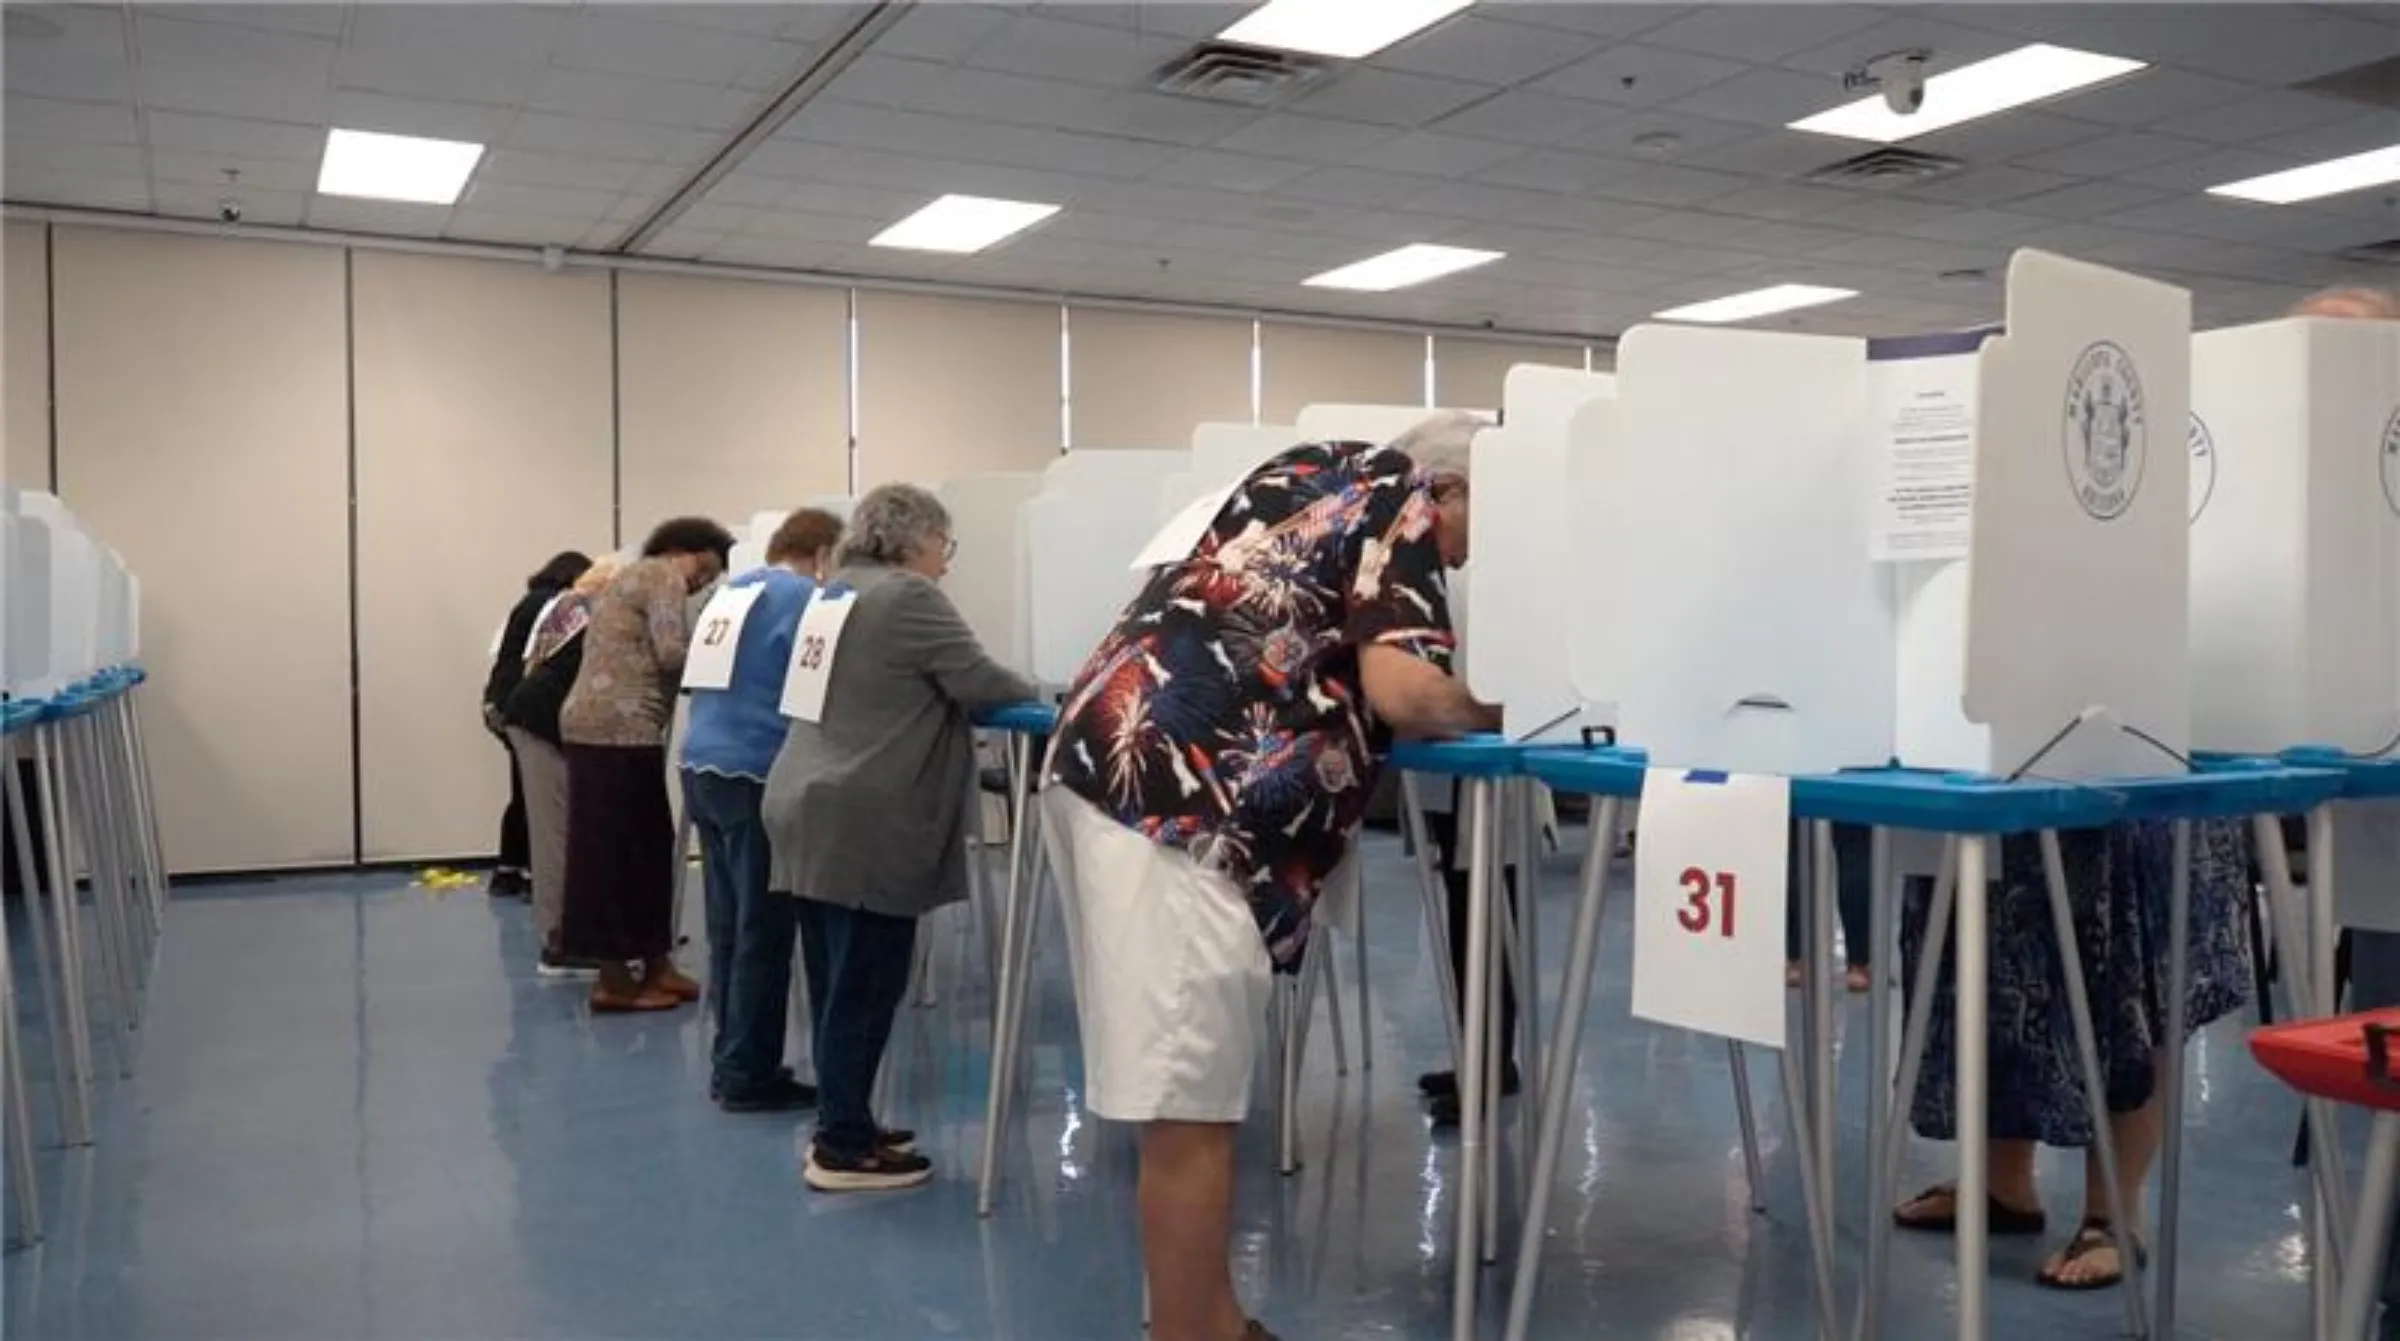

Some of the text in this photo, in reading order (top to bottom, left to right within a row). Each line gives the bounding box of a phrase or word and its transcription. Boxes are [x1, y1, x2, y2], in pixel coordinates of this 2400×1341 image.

[704, 618, 731, 645] 27
[800, 635, 826, 669] 28
[1677, 866, 1736, 938] 31
